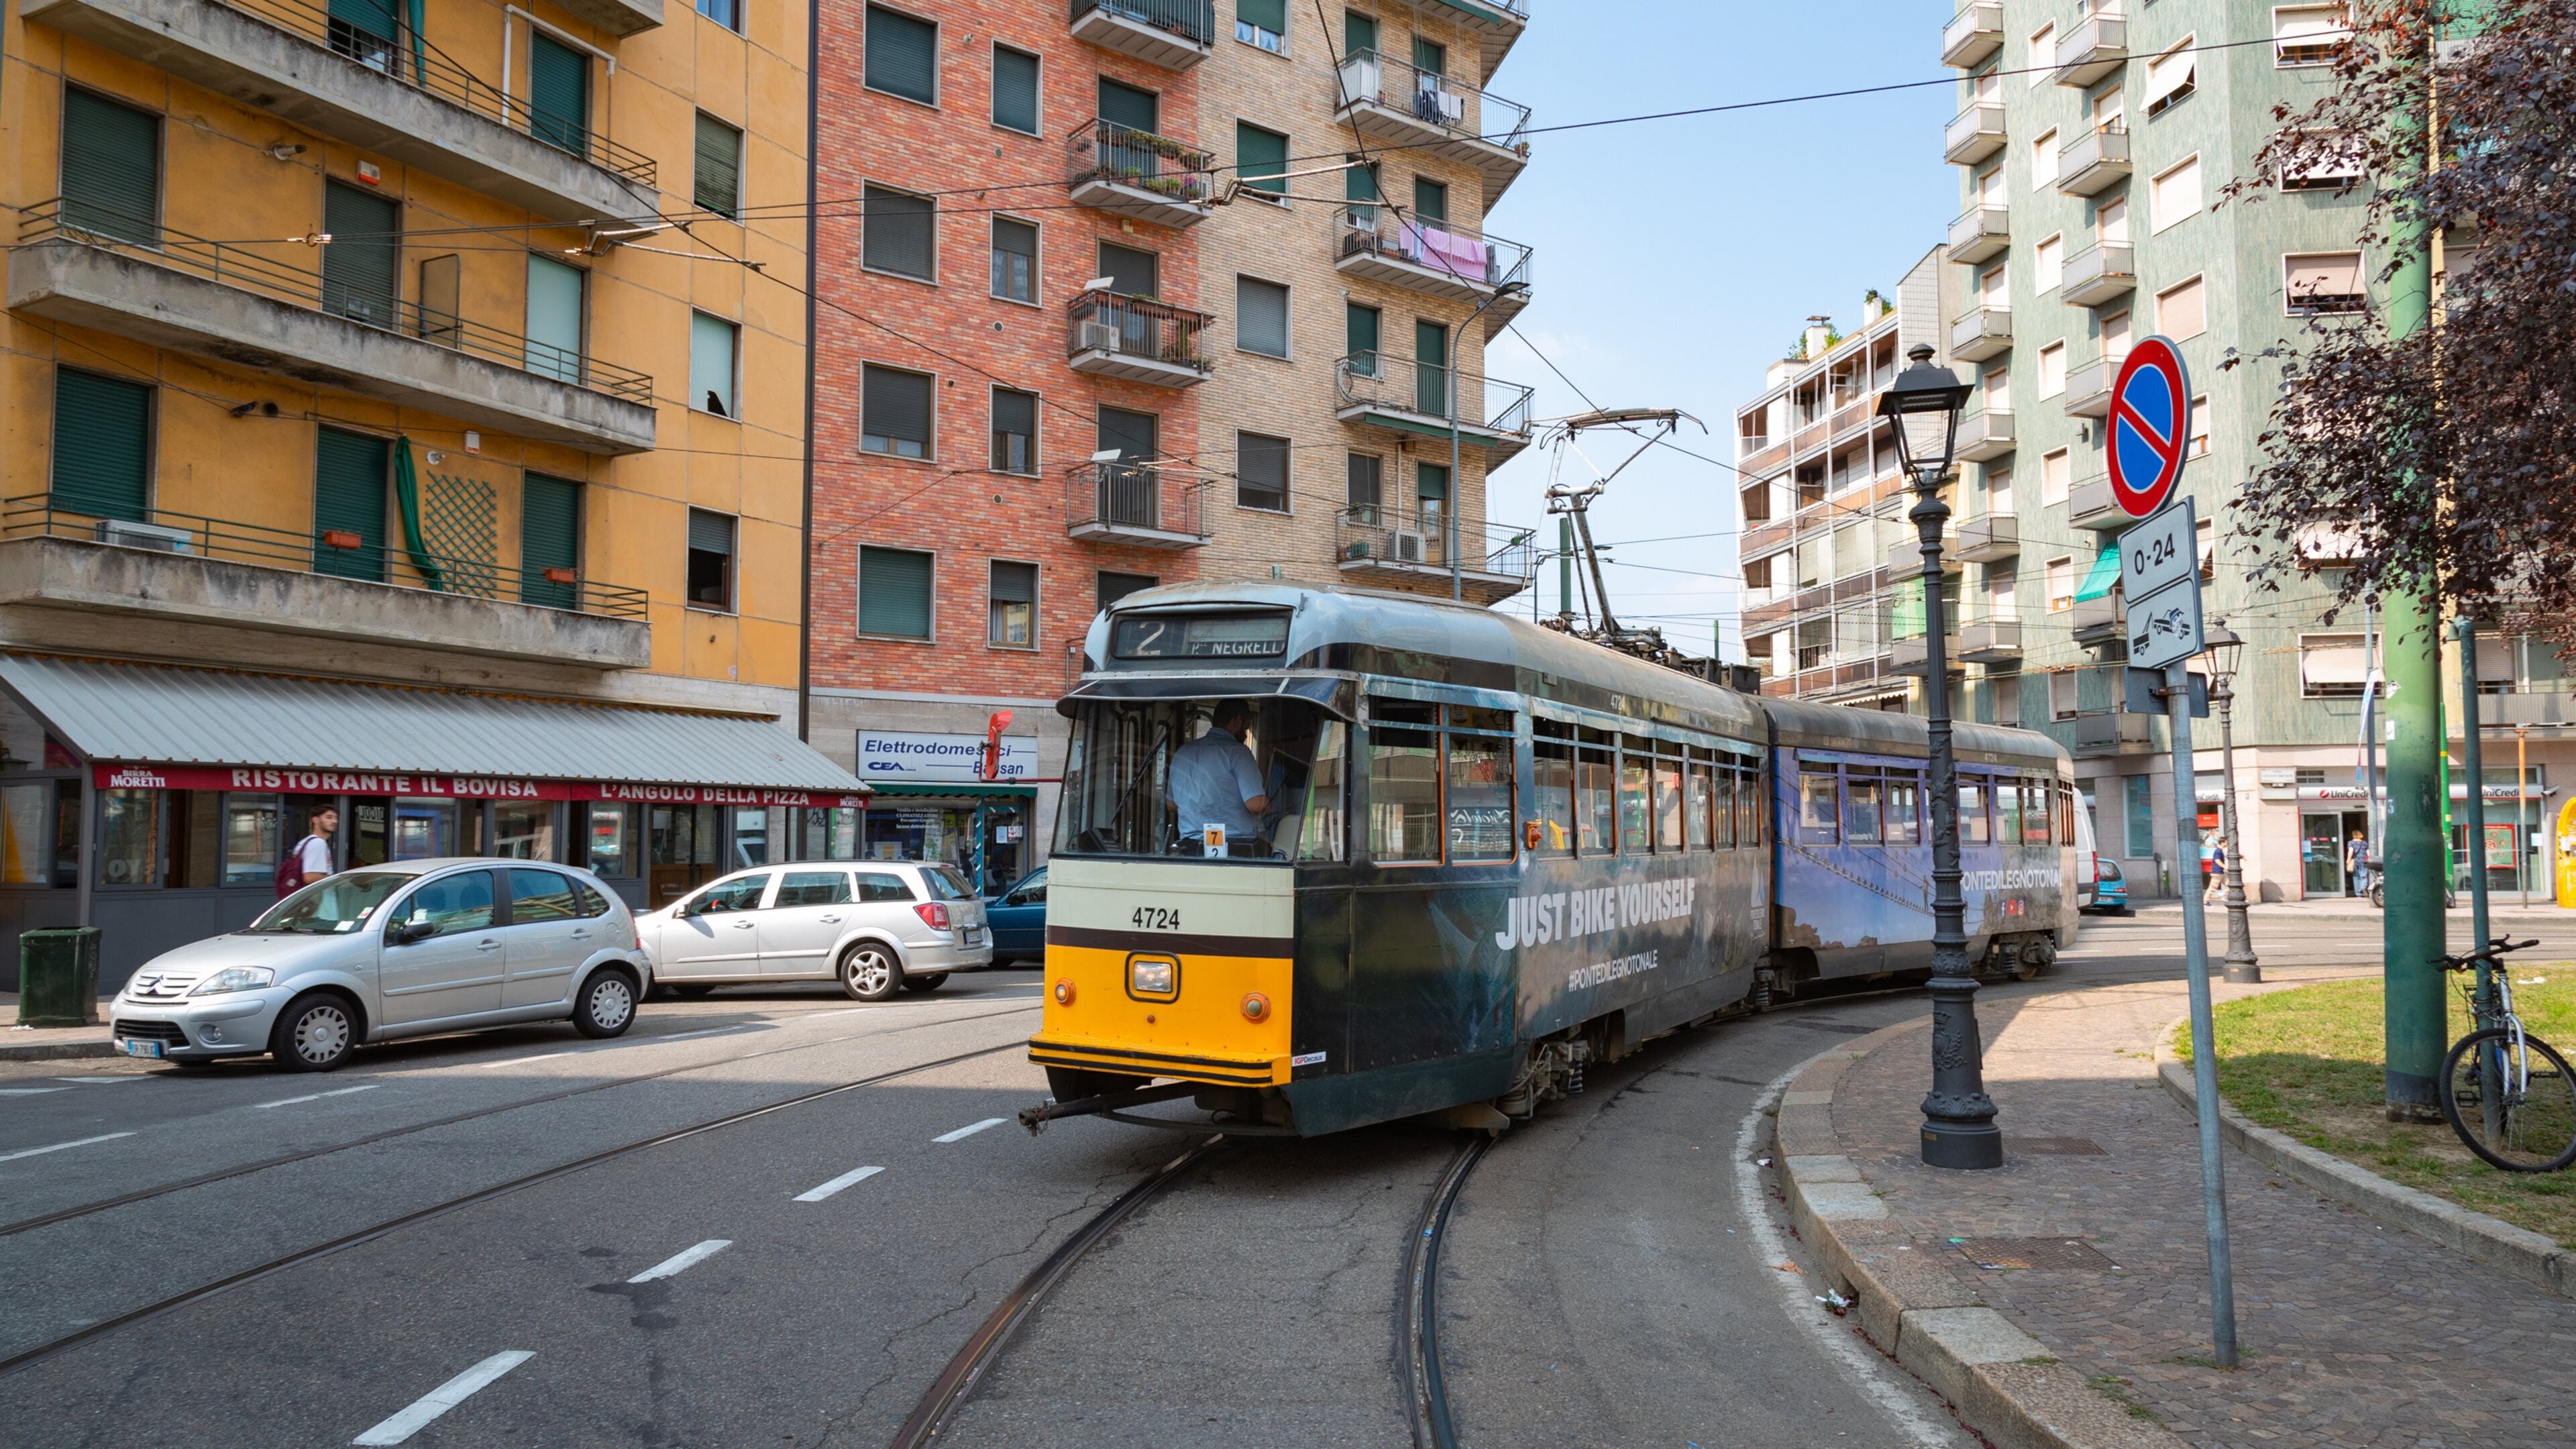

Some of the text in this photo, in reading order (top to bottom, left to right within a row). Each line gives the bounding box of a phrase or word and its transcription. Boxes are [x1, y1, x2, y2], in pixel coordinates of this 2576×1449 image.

[2135, 533, 2175, 575] 0-24
[1136, 621, 1165, 655] 2
[865, 740, 1012, 757] Elettrodomesci
[868, 761, 905, 771] CEA
[1984, 753, 1997, 763] 4724
[973, 761, 1024, 775] Basan
[111, 775, 166, 787] MORETTI
[232, 769, 539, 797] RISTORANTE IL BOVISA
[703, 788, 757, 804] DELLA
[763, 790, 809, 805] PIZZA
[2331, 790, 2370, 798] UniCredi
[1211, 832, 1218, 845] 7
[1132, 907, 1180, 930] 4724
[1496, 877, 1695, 951] JUST BIKE YOURSELF
[1568, 949, 1658, 992] #PONTEDILEGNOTONALE
